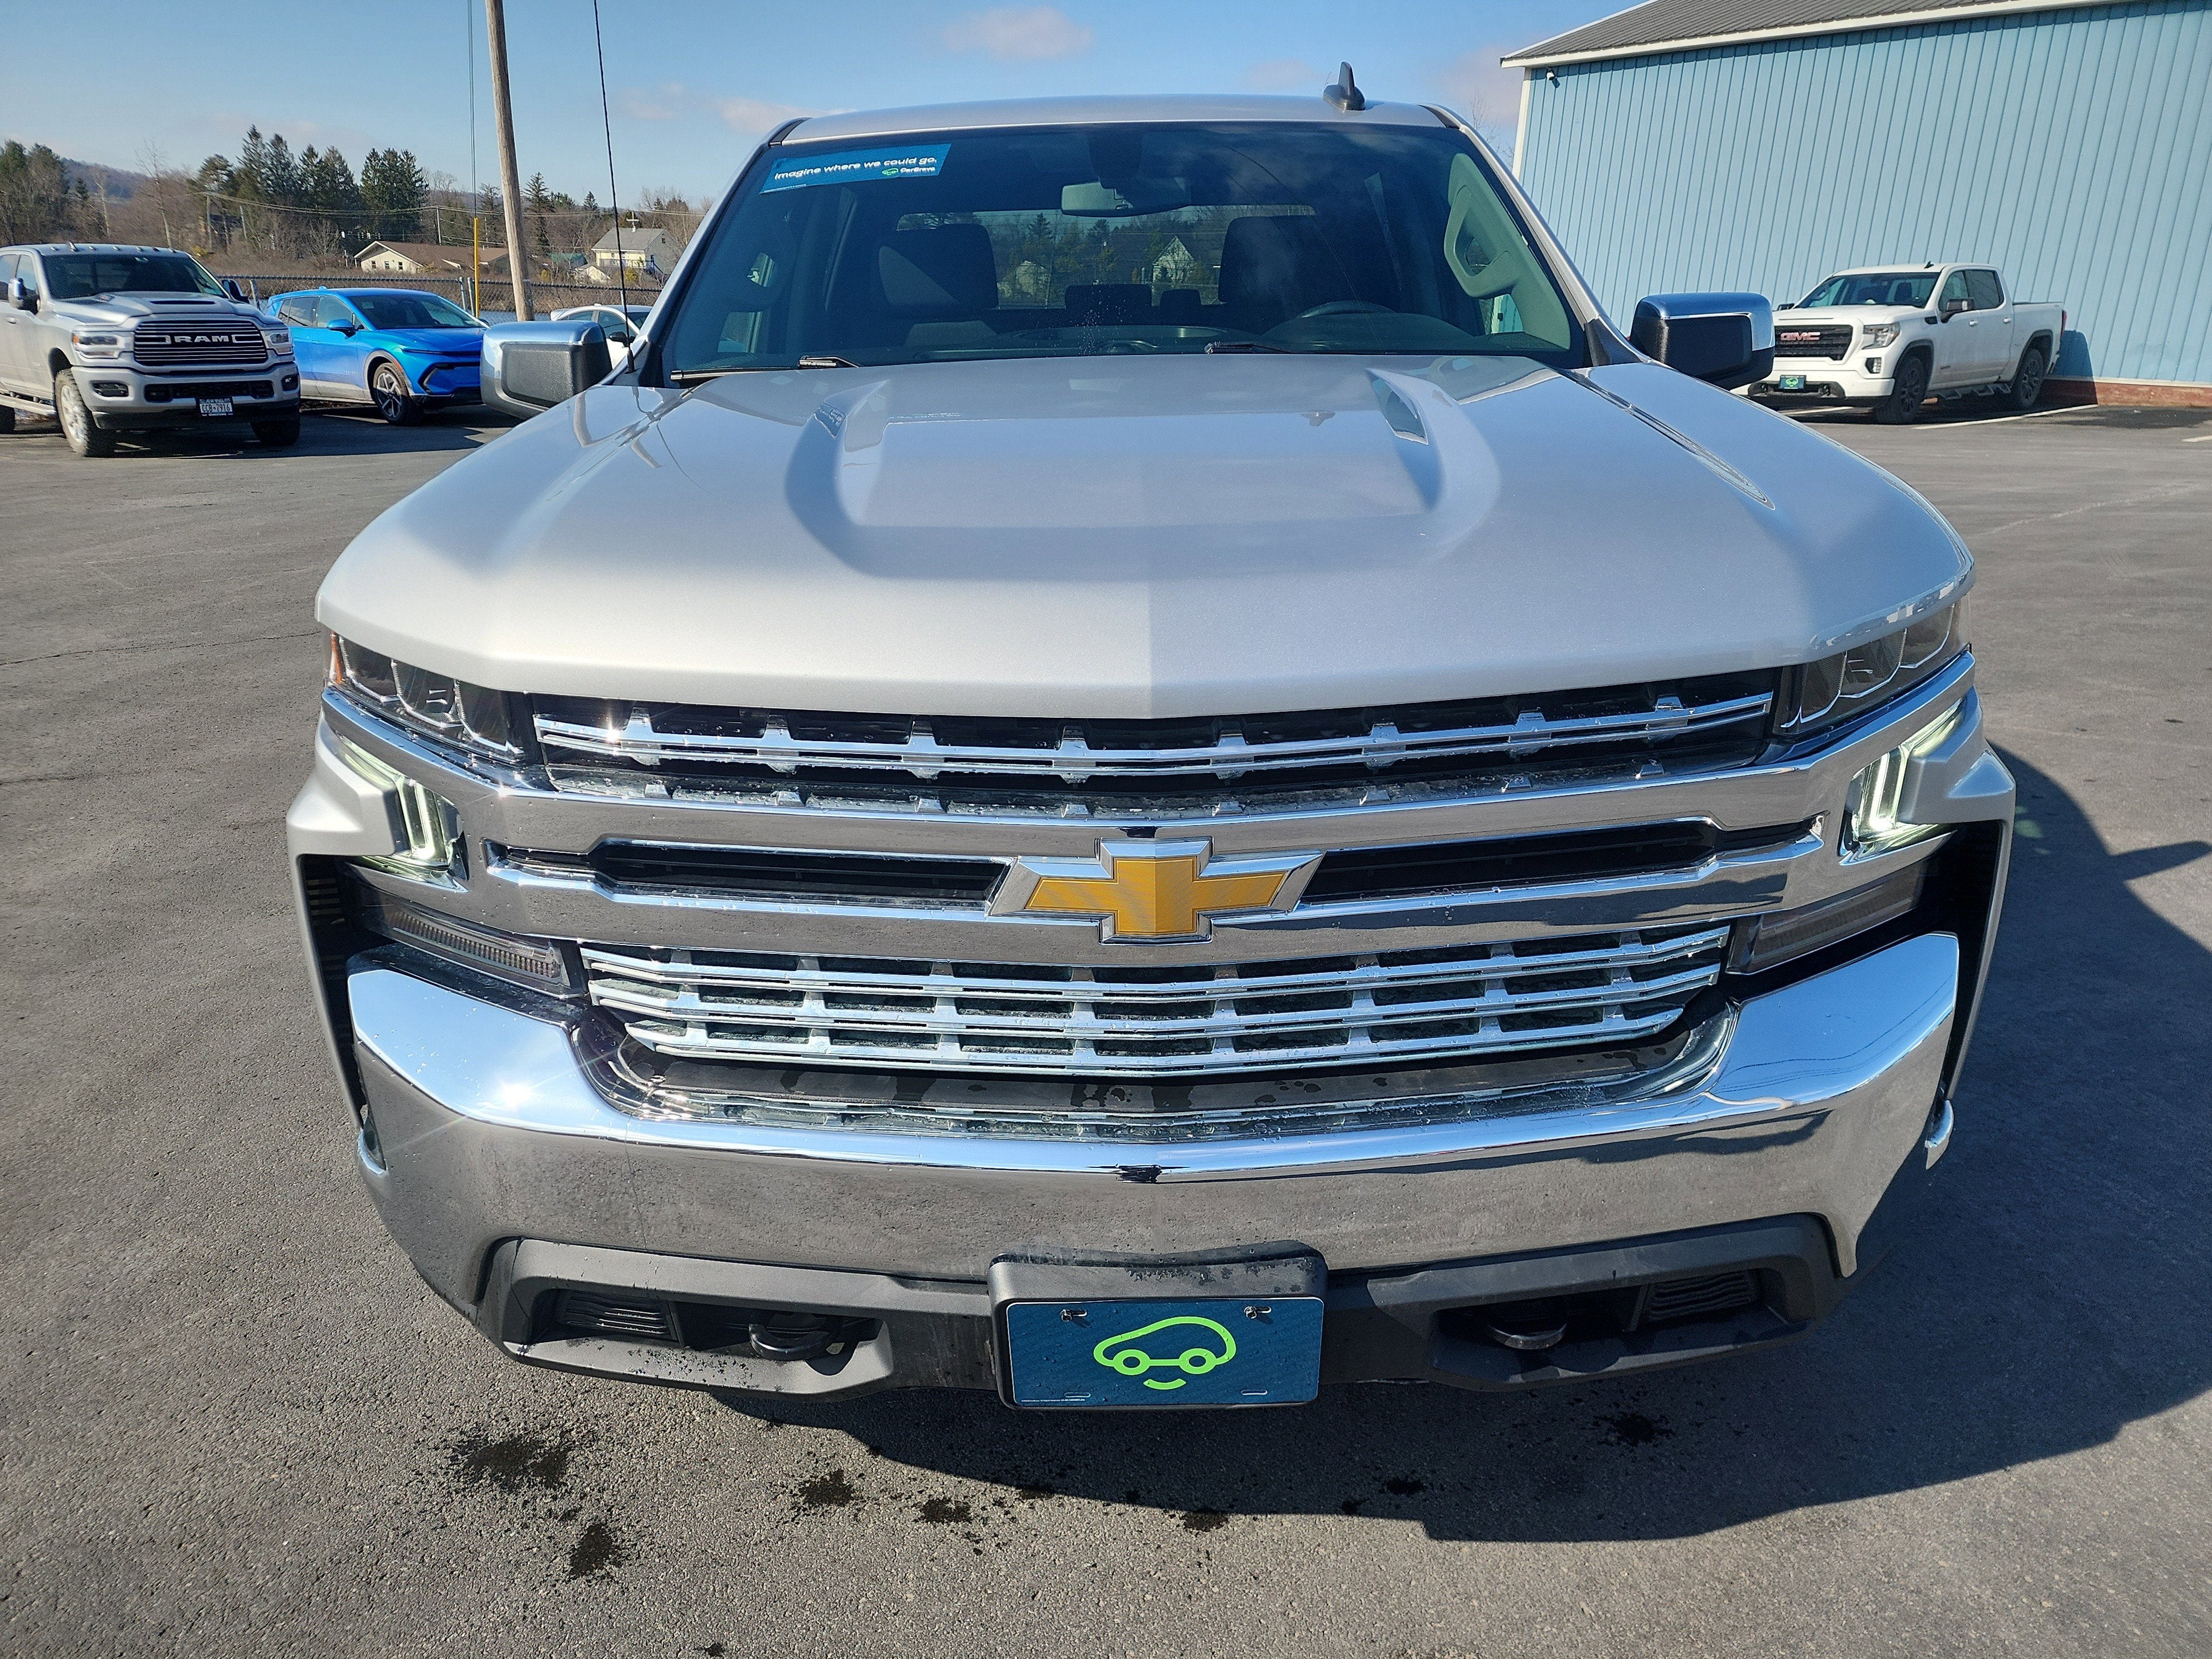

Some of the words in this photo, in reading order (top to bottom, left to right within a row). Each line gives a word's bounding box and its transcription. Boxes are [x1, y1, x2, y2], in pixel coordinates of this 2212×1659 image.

[775, 168, 821, 180] Imagine
[824, 163, 860, 173] where
[884, 158, 917, 166] could
[919, 157, 937, 165] go.
[1781, 332, 1820, 341] GMC
